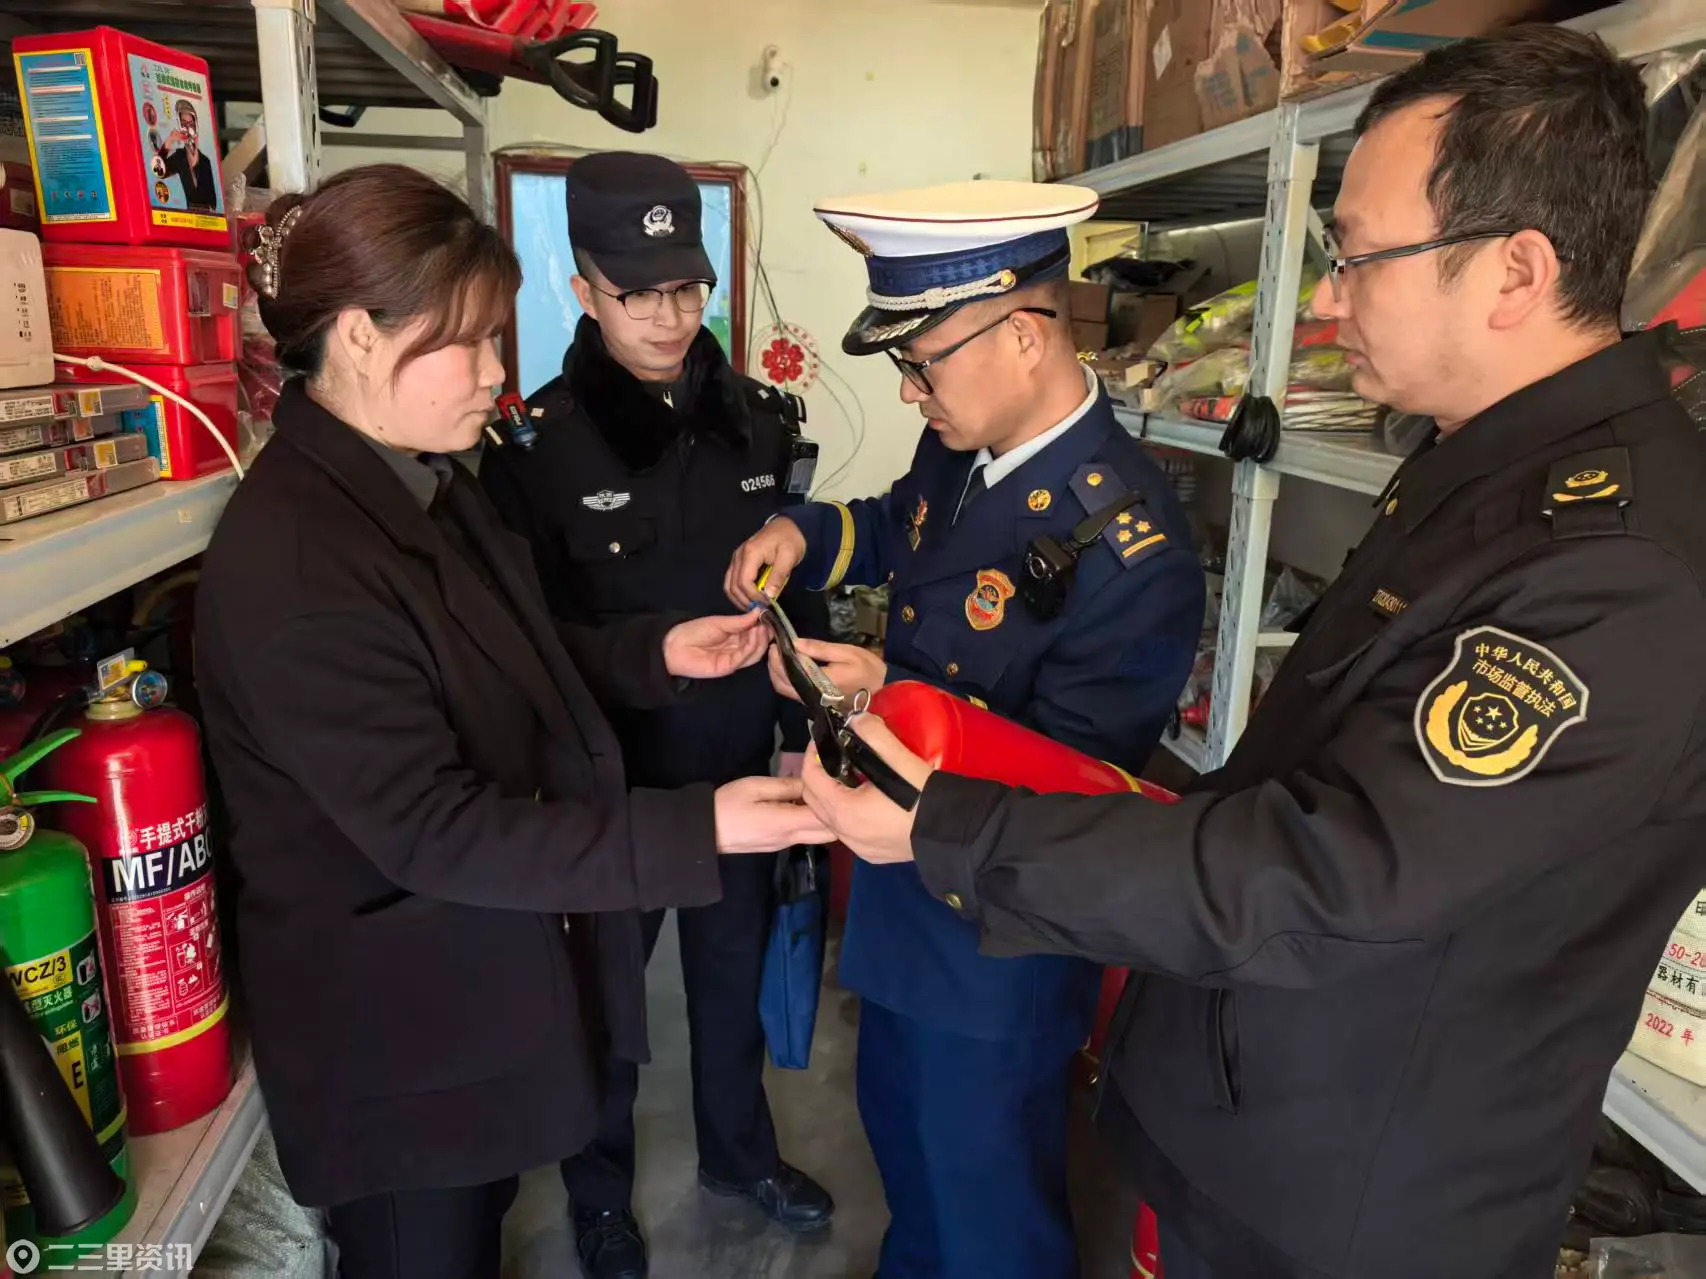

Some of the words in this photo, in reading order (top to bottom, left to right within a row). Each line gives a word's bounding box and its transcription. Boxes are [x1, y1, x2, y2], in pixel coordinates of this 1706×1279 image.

[1472, 658, 1558, 719] 市场监管执法
[1474, 642, 1577, 711] 中华人民共和国
[25, 985, 74, 1013] 型灭火器
[1657, 965, 1706, 997] 器材有
[1645, 1012, 1674, 1039] 2022
[1680, 1027, 1695, 1048] 年
